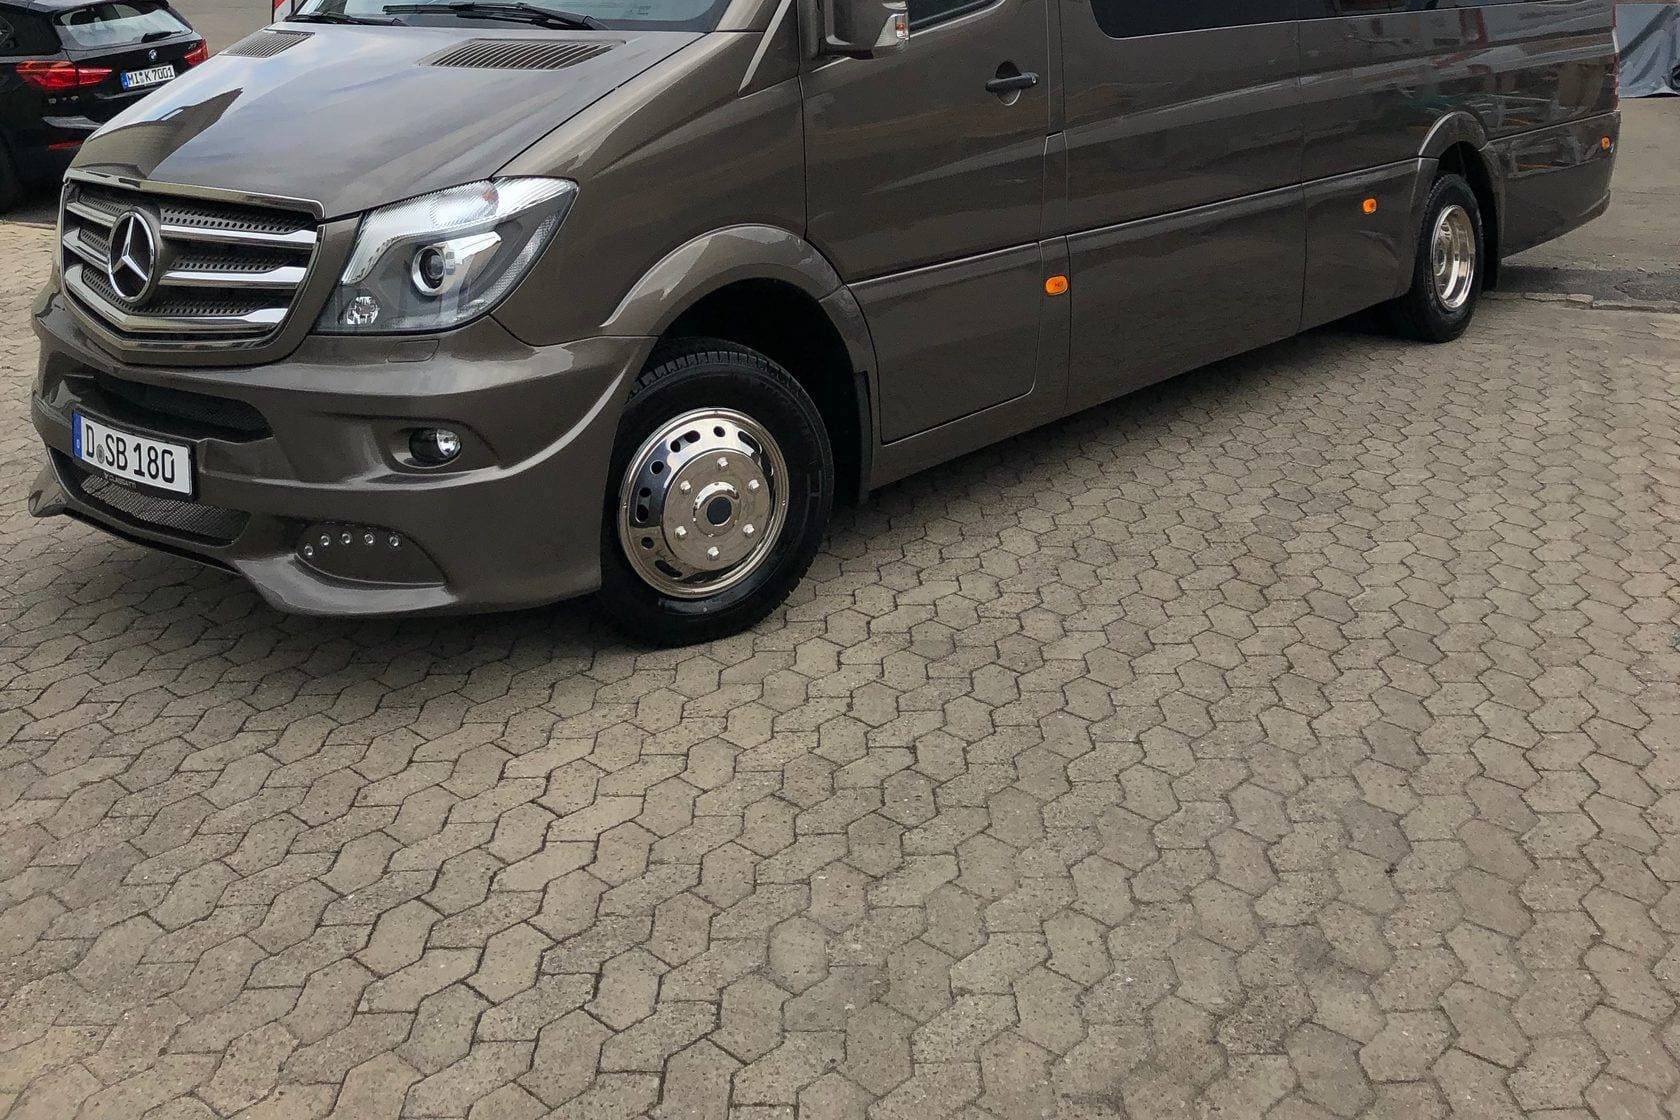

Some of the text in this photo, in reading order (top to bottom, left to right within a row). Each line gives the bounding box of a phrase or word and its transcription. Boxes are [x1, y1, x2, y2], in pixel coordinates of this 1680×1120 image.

[127, 66, 174, 87] MI K 7001
[85, 423, 95, 458] D
[105, 433, 128, 471] SB
[133, 442, 175, 484] 180
